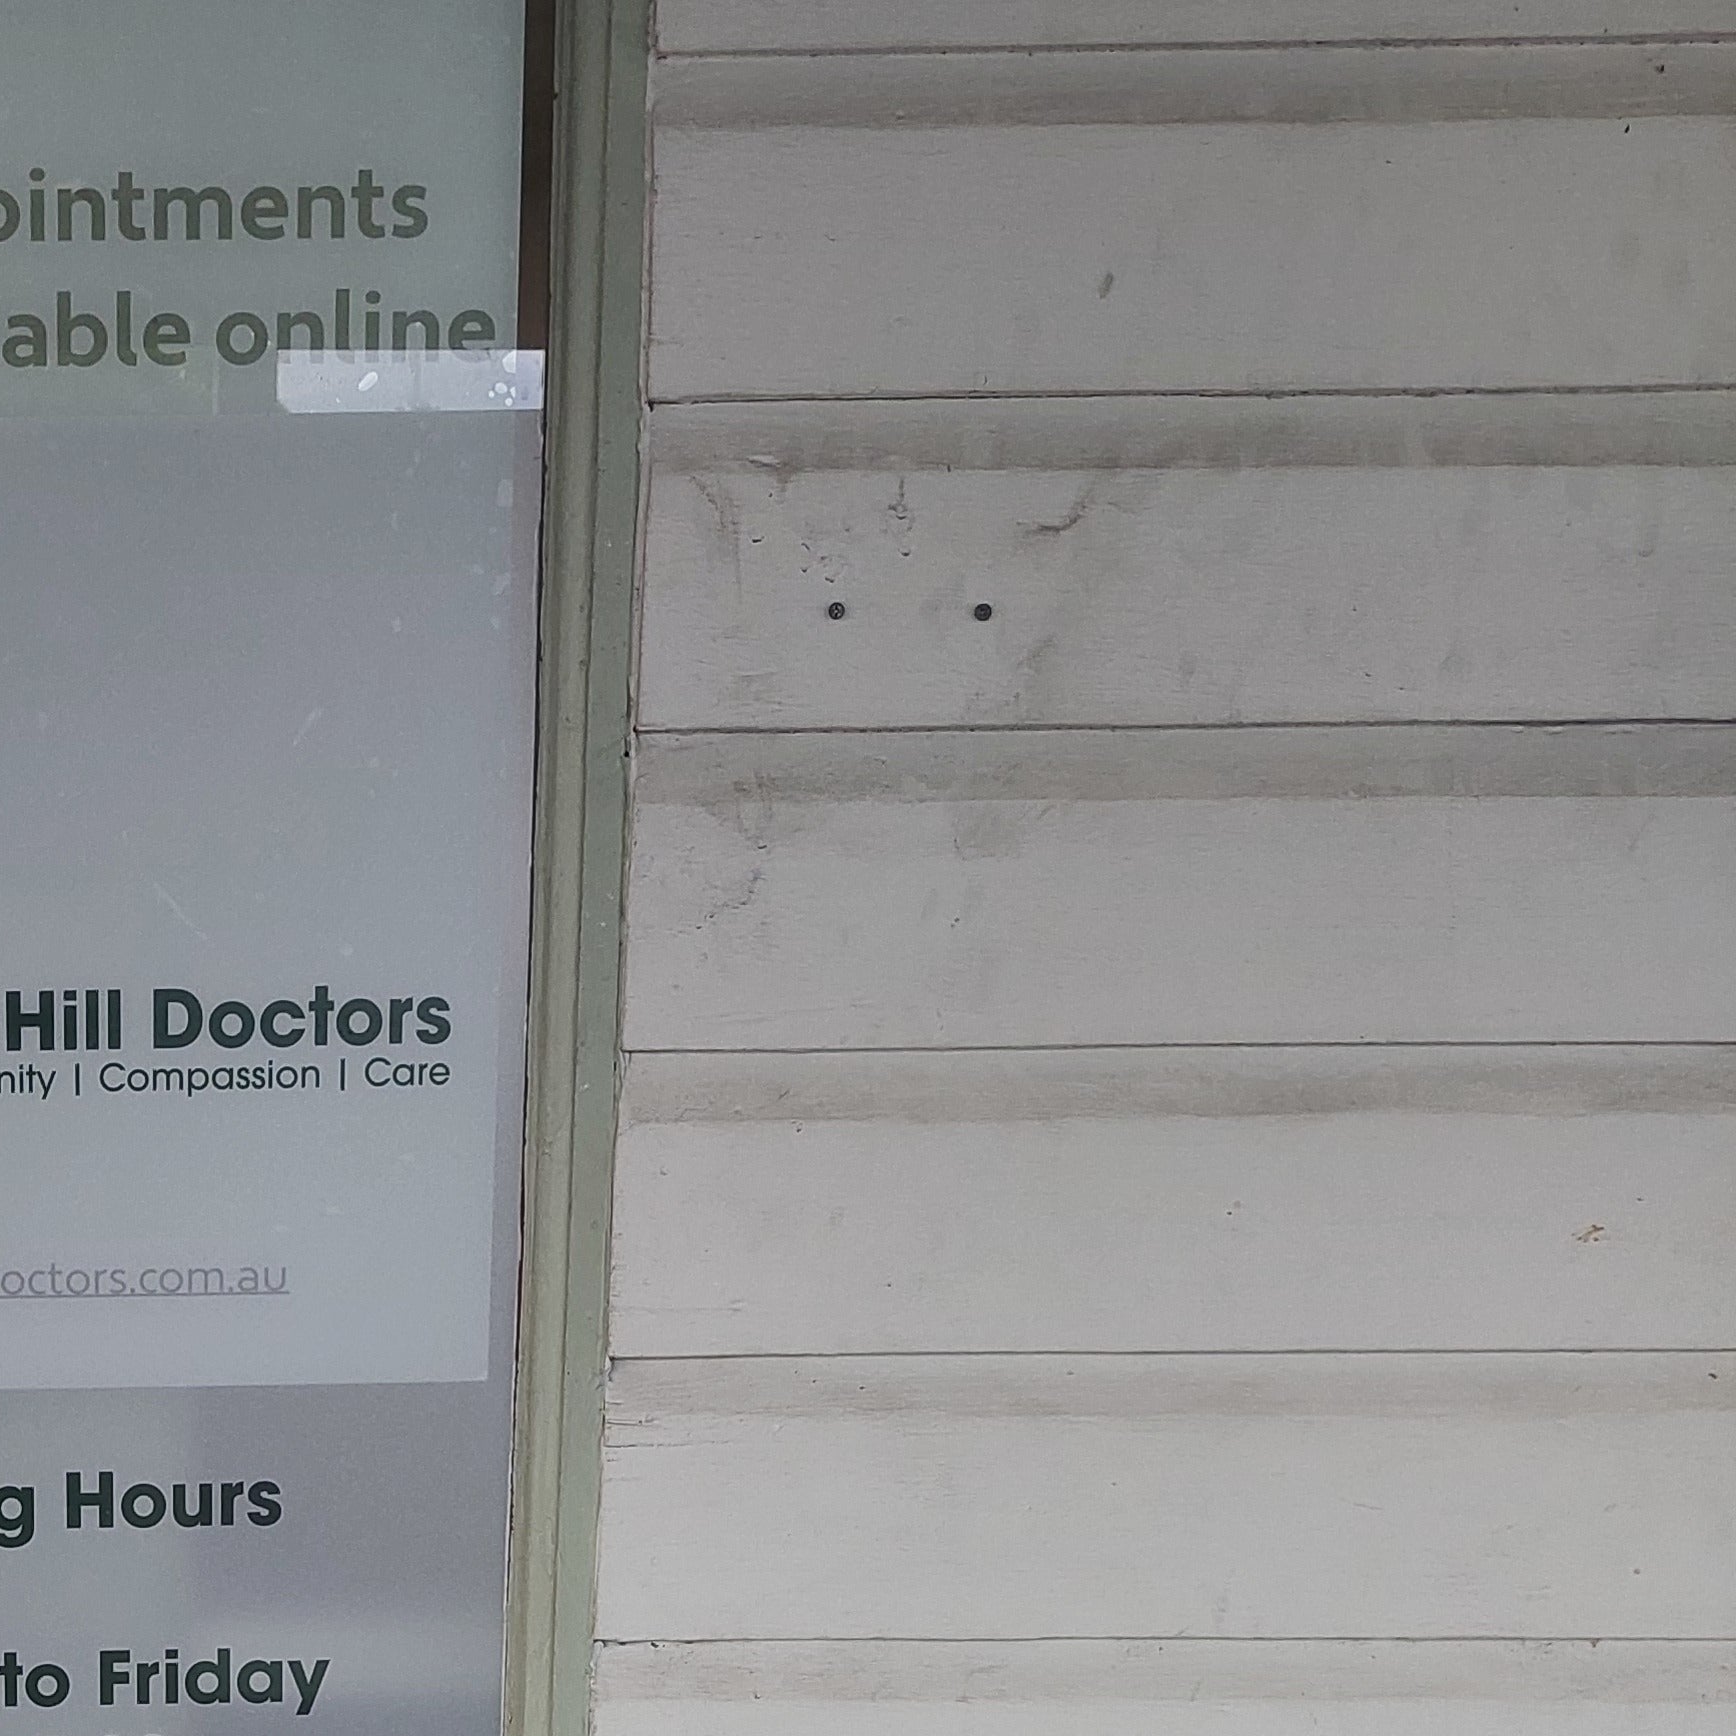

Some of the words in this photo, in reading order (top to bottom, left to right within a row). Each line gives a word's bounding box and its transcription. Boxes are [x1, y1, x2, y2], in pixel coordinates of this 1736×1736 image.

[216, 289, 495, 365] online
[6, 989, 121, 1051] Hill
[153, 986, 451, 1049] Doctors
[99, 1060, 320, 1095] Compassion
[365, 1057, 450, 1087] Care
[66, 1471, 282, 1529] Hours
[99, 1648, 330, 1716] Friday
